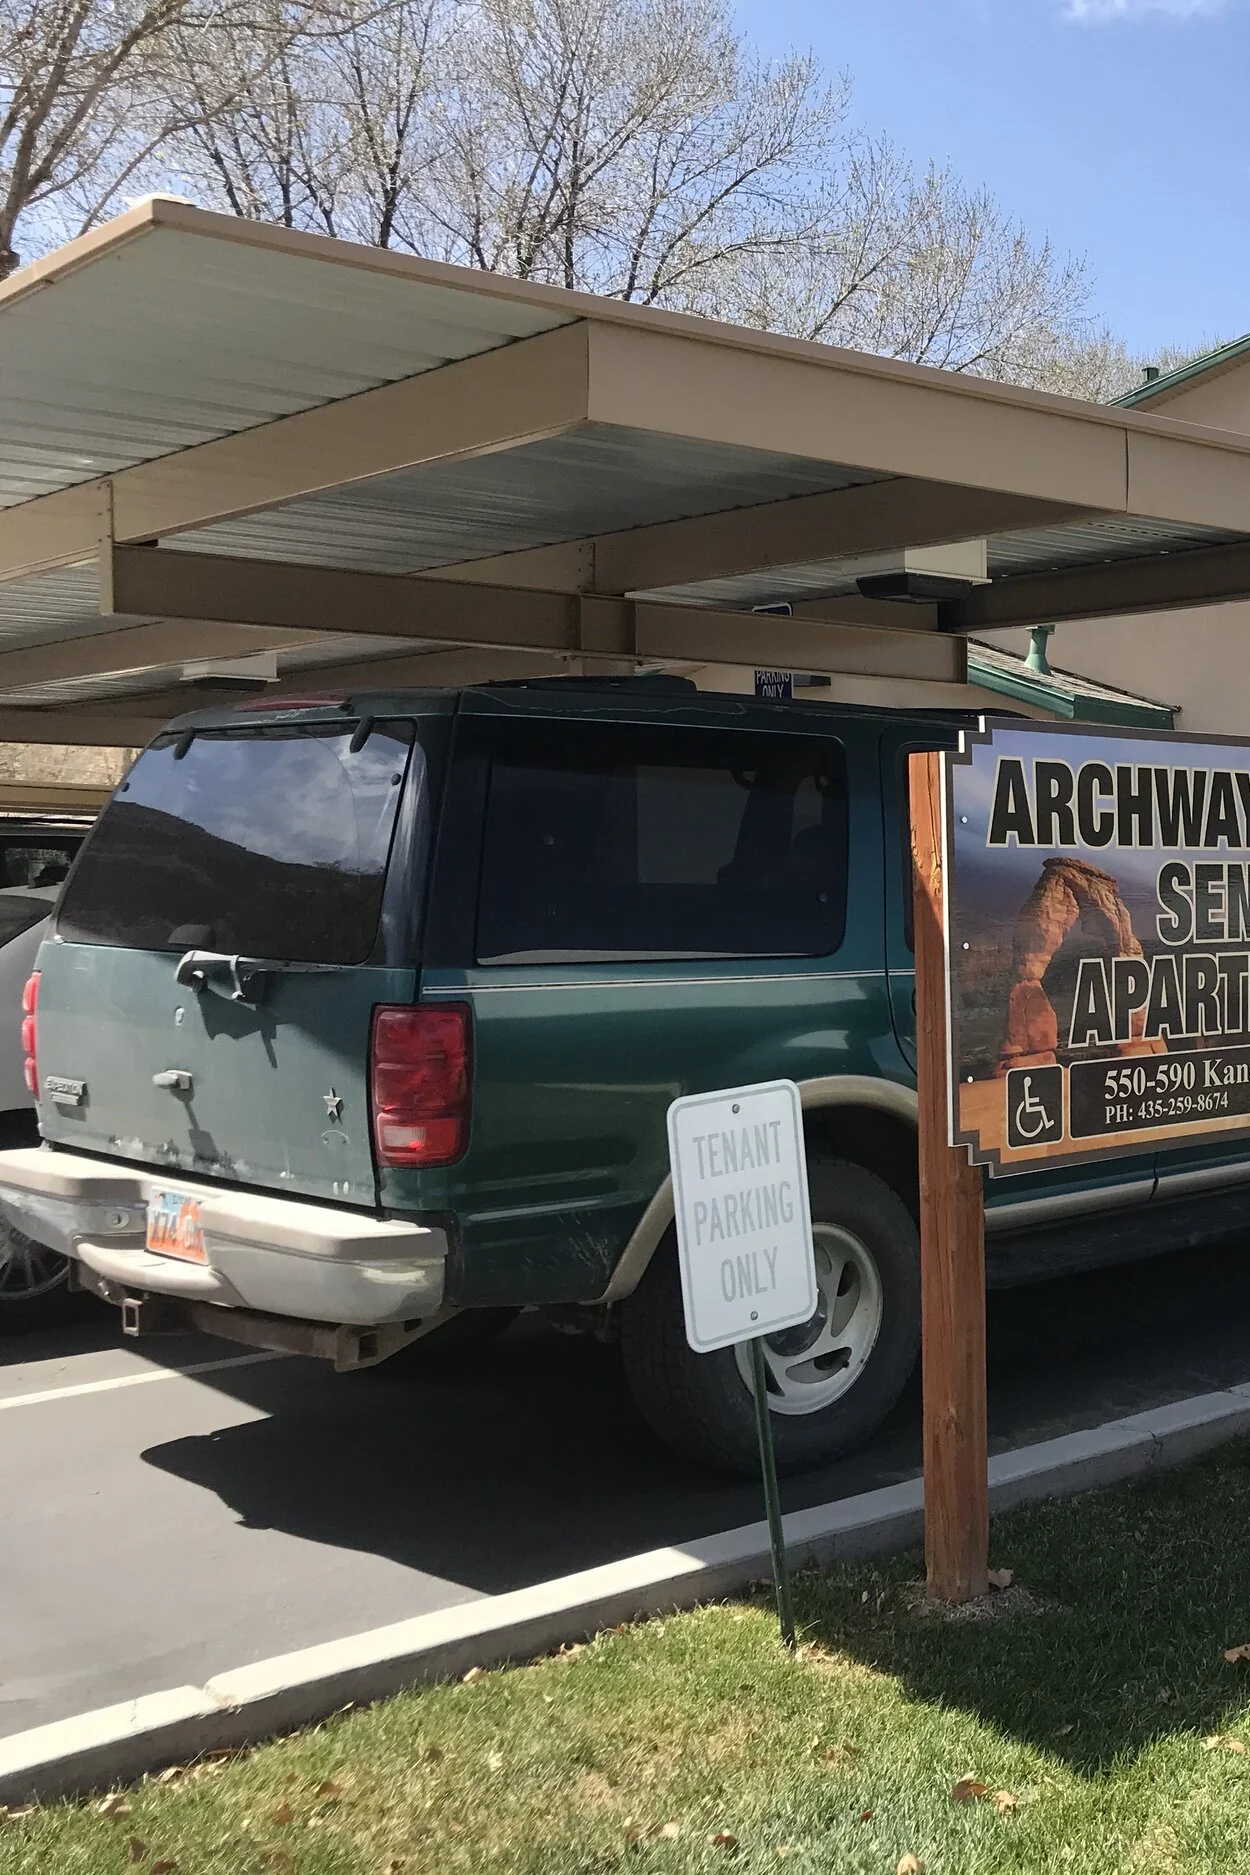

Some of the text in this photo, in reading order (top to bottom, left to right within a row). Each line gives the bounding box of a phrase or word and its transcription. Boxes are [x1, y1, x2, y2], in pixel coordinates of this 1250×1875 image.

[756, 671, 790, 685] PARKING
[762, 684, 784, 698] ONLY
[1104, 1061, 1196, 1100] 550-590
[1105, 1091, 1229, 1124] PH: 435-259-8674
[692, 1120, 782, 1180] TENANT
[693, 1181, 794, 1247] PARKING
[720, 1246, 779, 1303] ONLY
